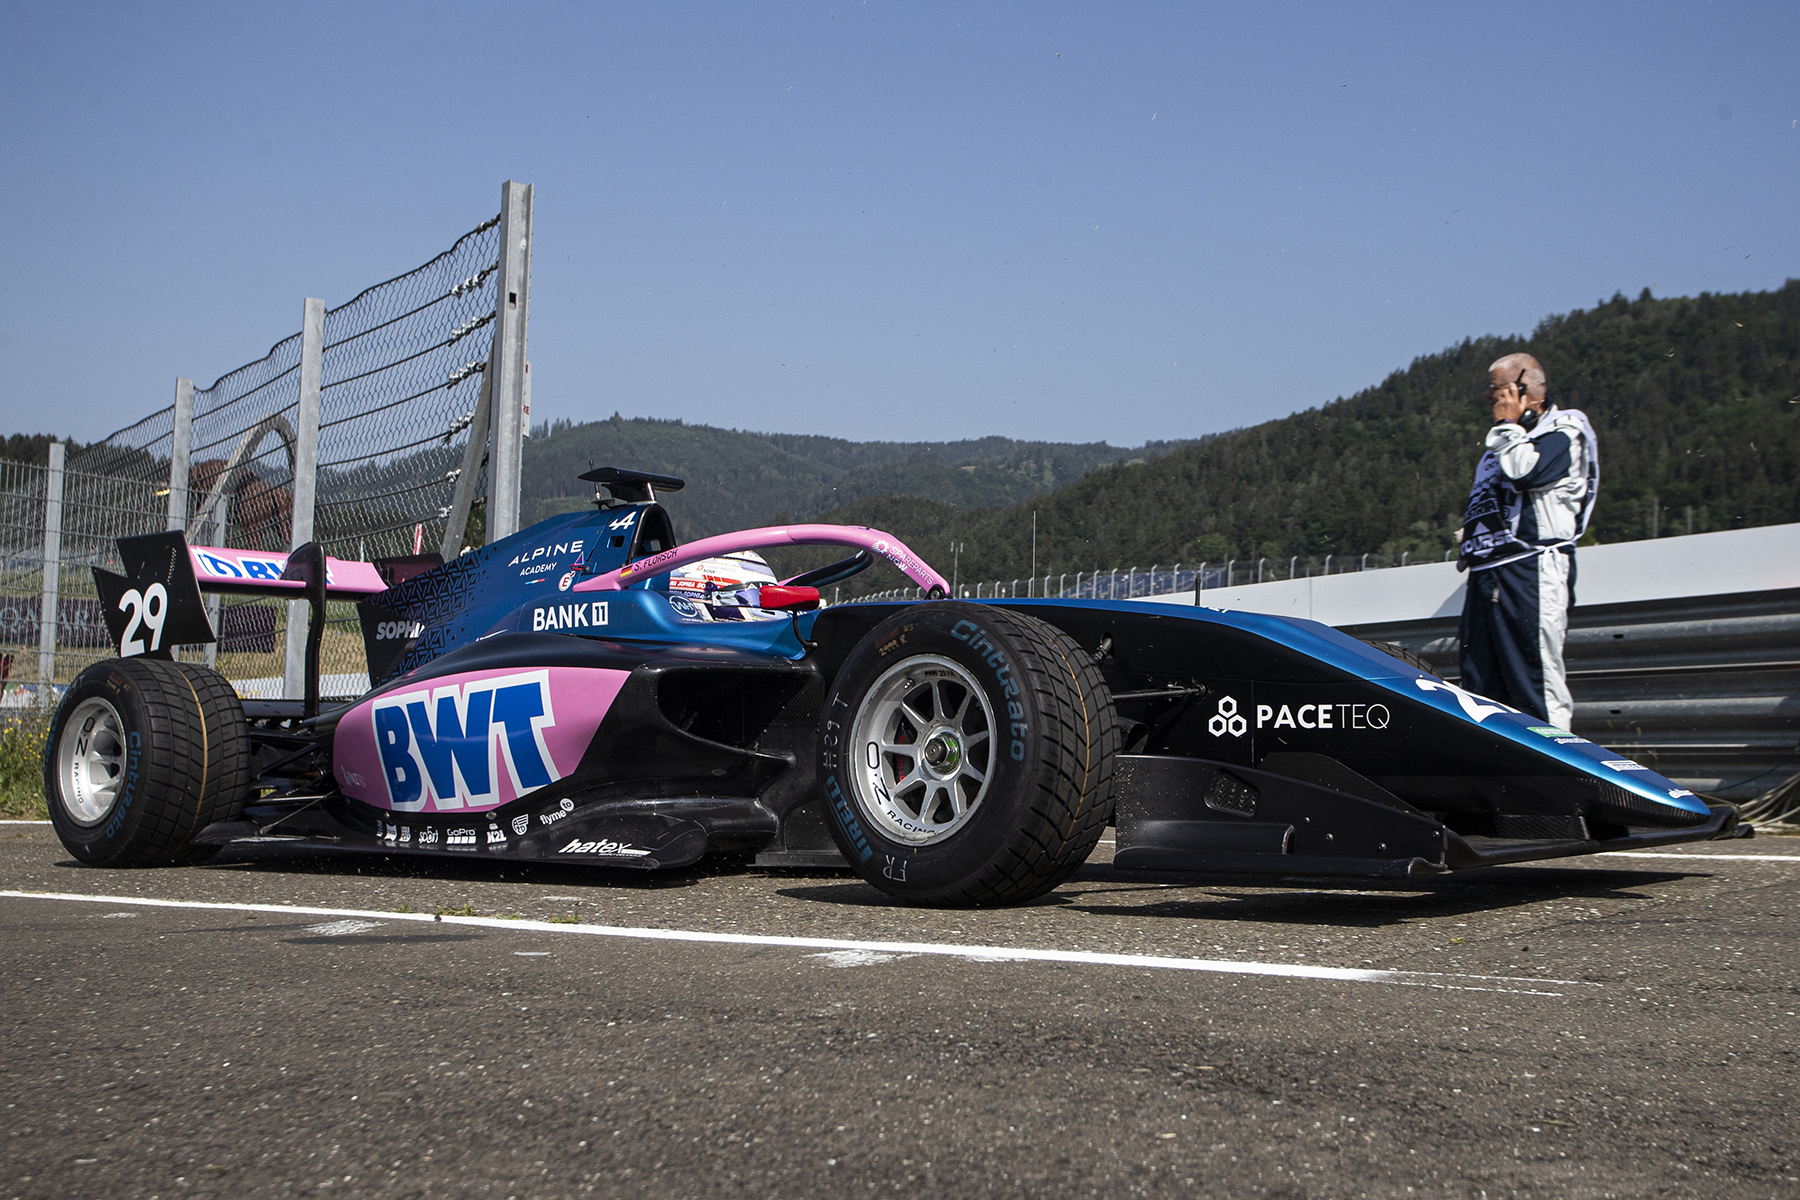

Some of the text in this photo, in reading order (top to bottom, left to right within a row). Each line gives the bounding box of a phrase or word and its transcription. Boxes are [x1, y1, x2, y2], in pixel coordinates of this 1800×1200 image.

[508, 540, 584, 567] ALPINE
[886, 553, 908, 571] NOW
[889, 546, 934, 585] SPAREPARTS
[519, 562, 557, 576] ACADEMY
[118, 582, 168, 658] 29
[533, 603, 589, 631] BANK
[950, 619, 1028, 762] Cinturato
[372, 672, 558, 811] BWT
[446, 828, 476, 837] GoPro
[558, 839, 632, 854] hatex
